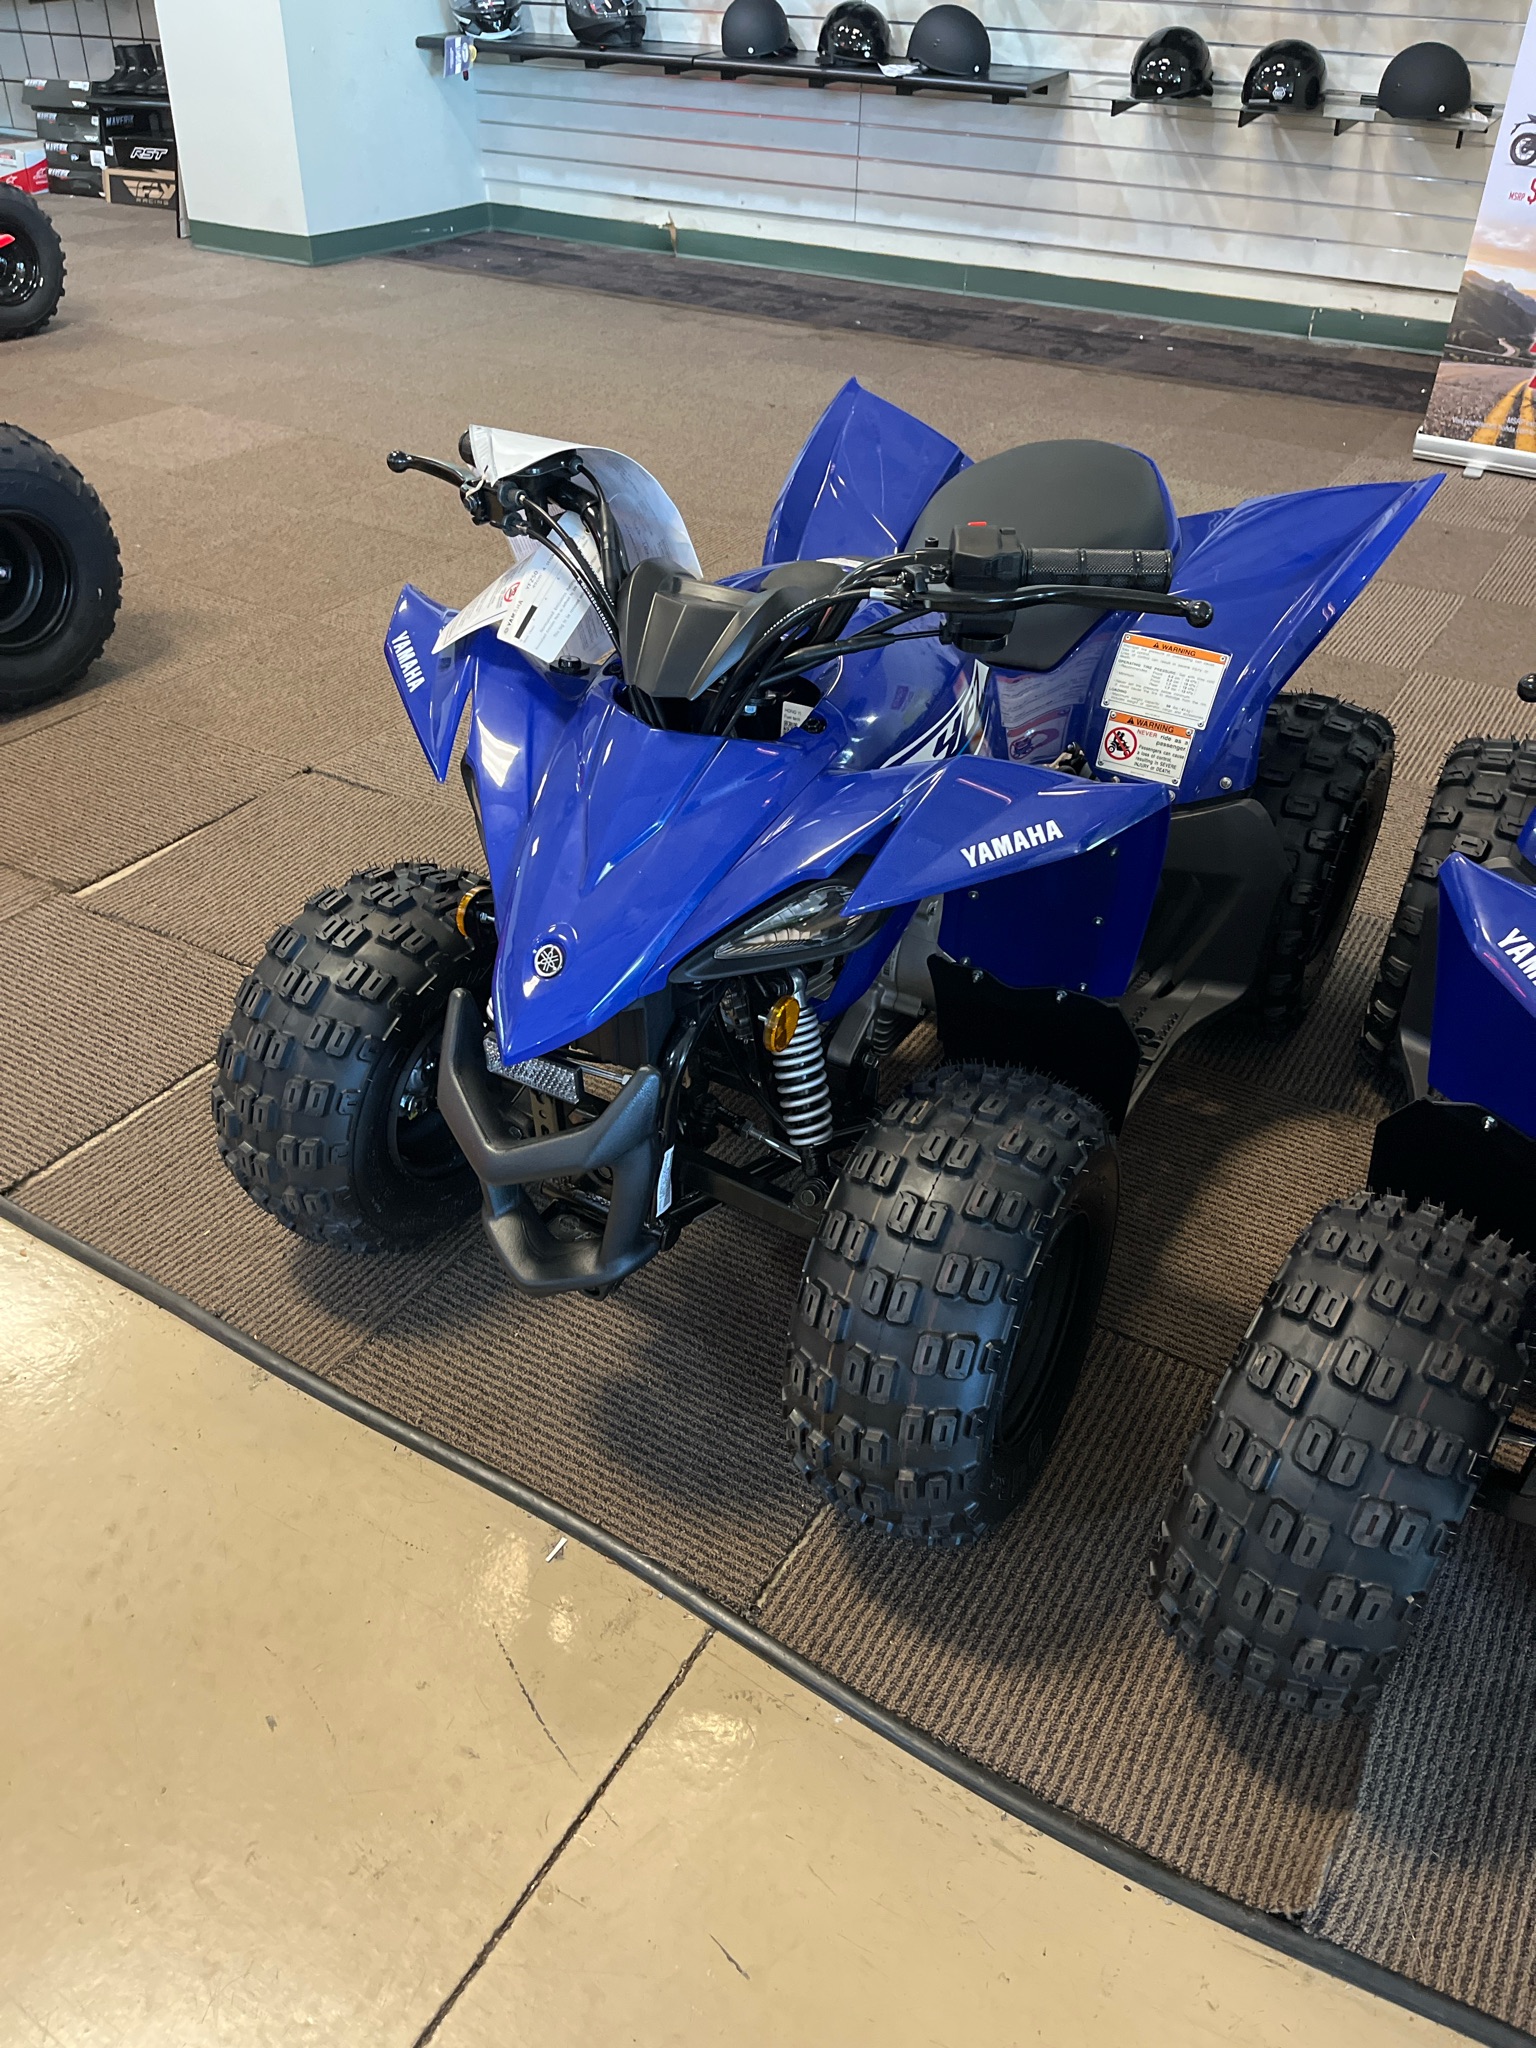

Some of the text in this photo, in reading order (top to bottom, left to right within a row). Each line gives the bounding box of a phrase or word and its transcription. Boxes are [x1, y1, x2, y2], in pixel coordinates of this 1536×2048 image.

[106, 115, 134, 127] MAVERIK
[130, 147, 168, 161] RST
[132, 180, 176, 199] FLY
[1509, 191, 1526, 201] MSRP
[504, 599, 525, 626] YAMAHA
[1161, 643, 1196, 656] WARNING
[391, 630, 425, 693] YAMAHA
[1136, 719, 1174, 732] WARNING
[1136, 729, 1157, 738] NEVER
[960, 819, 1064, 868] YAMAHA
[1497, 928, 1536, 987] YAM
